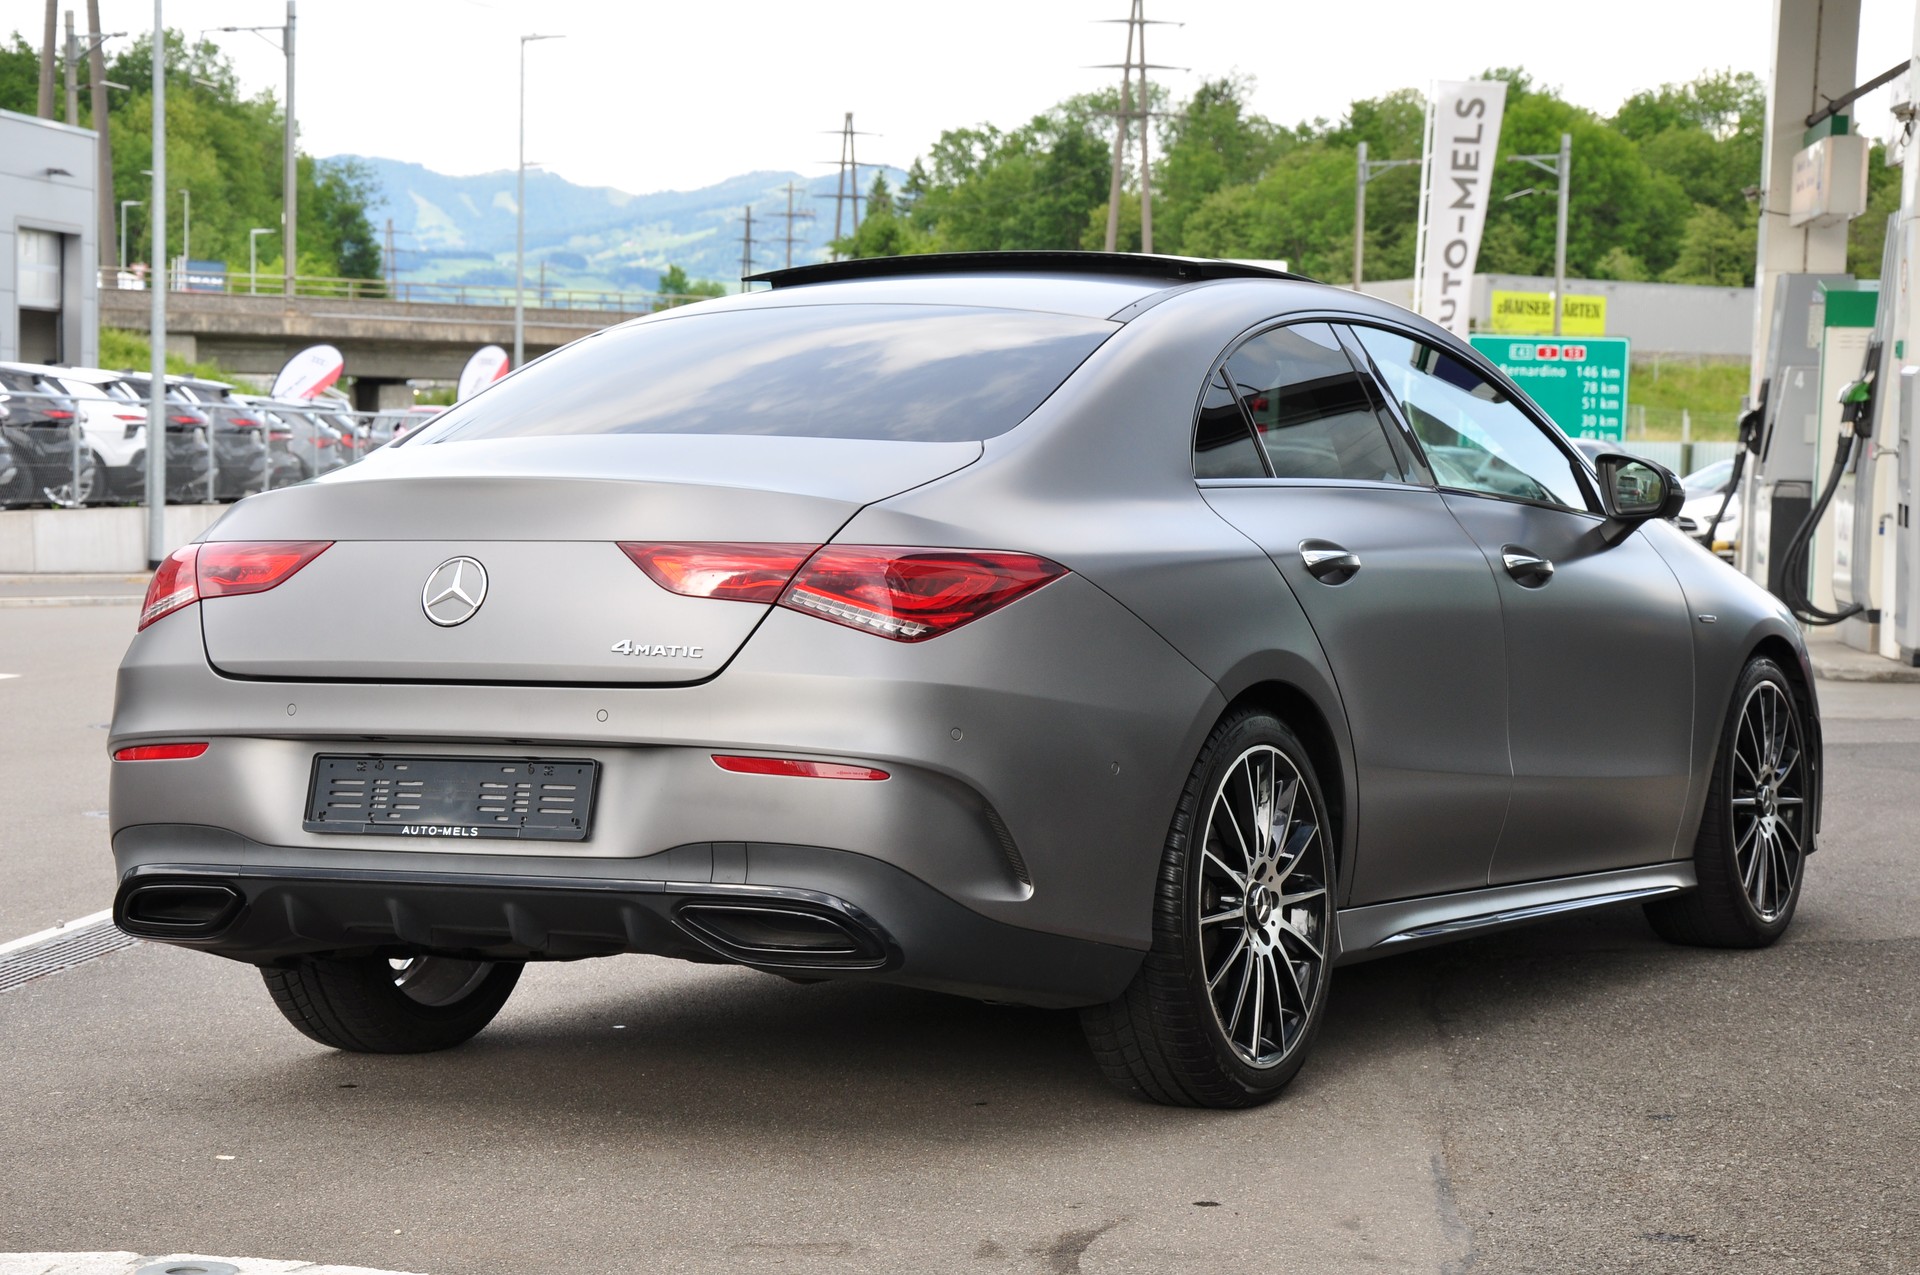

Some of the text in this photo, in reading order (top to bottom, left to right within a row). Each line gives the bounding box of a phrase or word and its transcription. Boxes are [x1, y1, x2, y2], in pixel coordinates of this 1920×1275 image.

[1439, 97, 1486, 331] UTO-MELS
[1576, 366, 1598, 378] 146
[1602, 366, 1620, 378] km
[1583, 381, 1619, 394] 78 km
[1582, 397, 1619, 410] 51 km
[1581, 414, 1618, 427] 30 km
[1599, 430, 1617, 440] km
[611, 639, 703, 658] 4MATIC
[402, 825, 478, 837] AUTO-MELS
